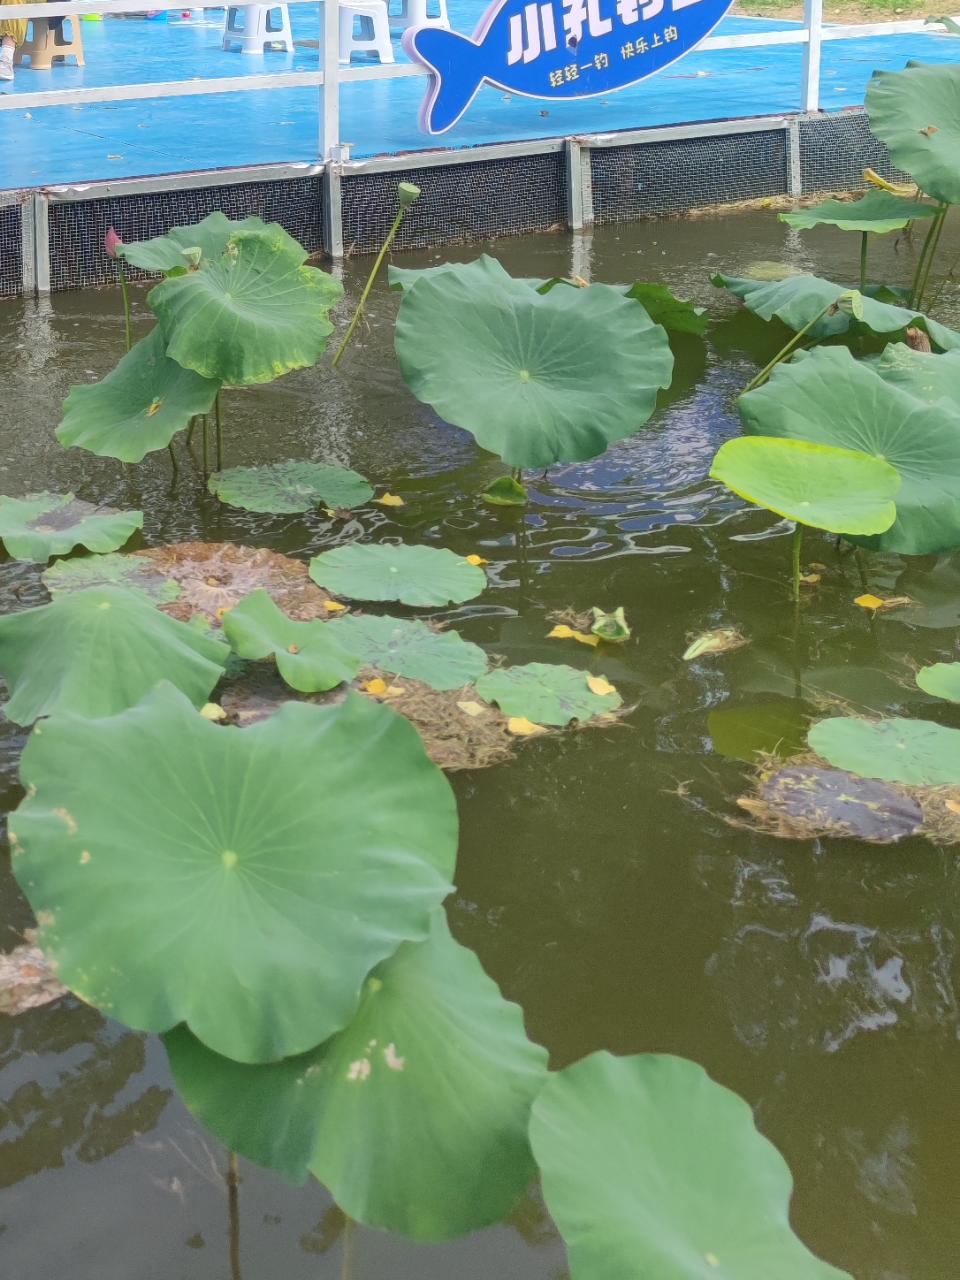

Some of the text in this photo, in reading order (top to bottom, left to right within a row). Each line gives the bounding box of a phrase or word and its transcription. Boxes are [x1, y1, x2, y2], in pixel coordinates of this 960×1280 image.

[549, 24, 679, 88] 轻轻一钓 快乐上钩
